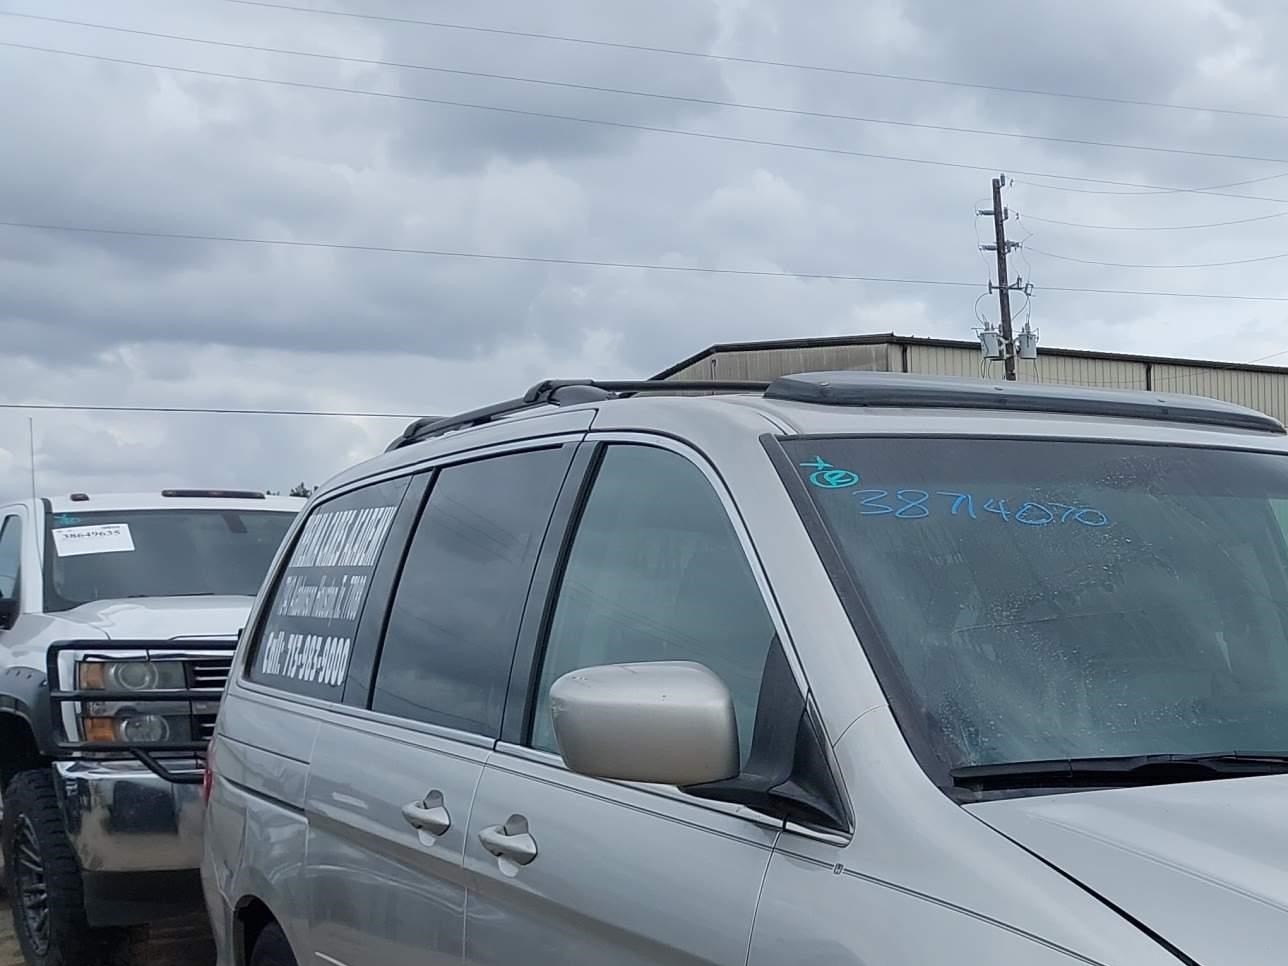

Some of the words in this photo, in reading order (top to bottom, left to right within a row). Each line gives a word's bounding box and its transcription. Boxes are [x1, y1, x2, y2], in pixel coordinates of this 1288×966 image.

[852, 489, 1108, 526] 38714070
[62, 529, 121, 540] 38649635
[282, 633, 351, 687] 713-983-9000
